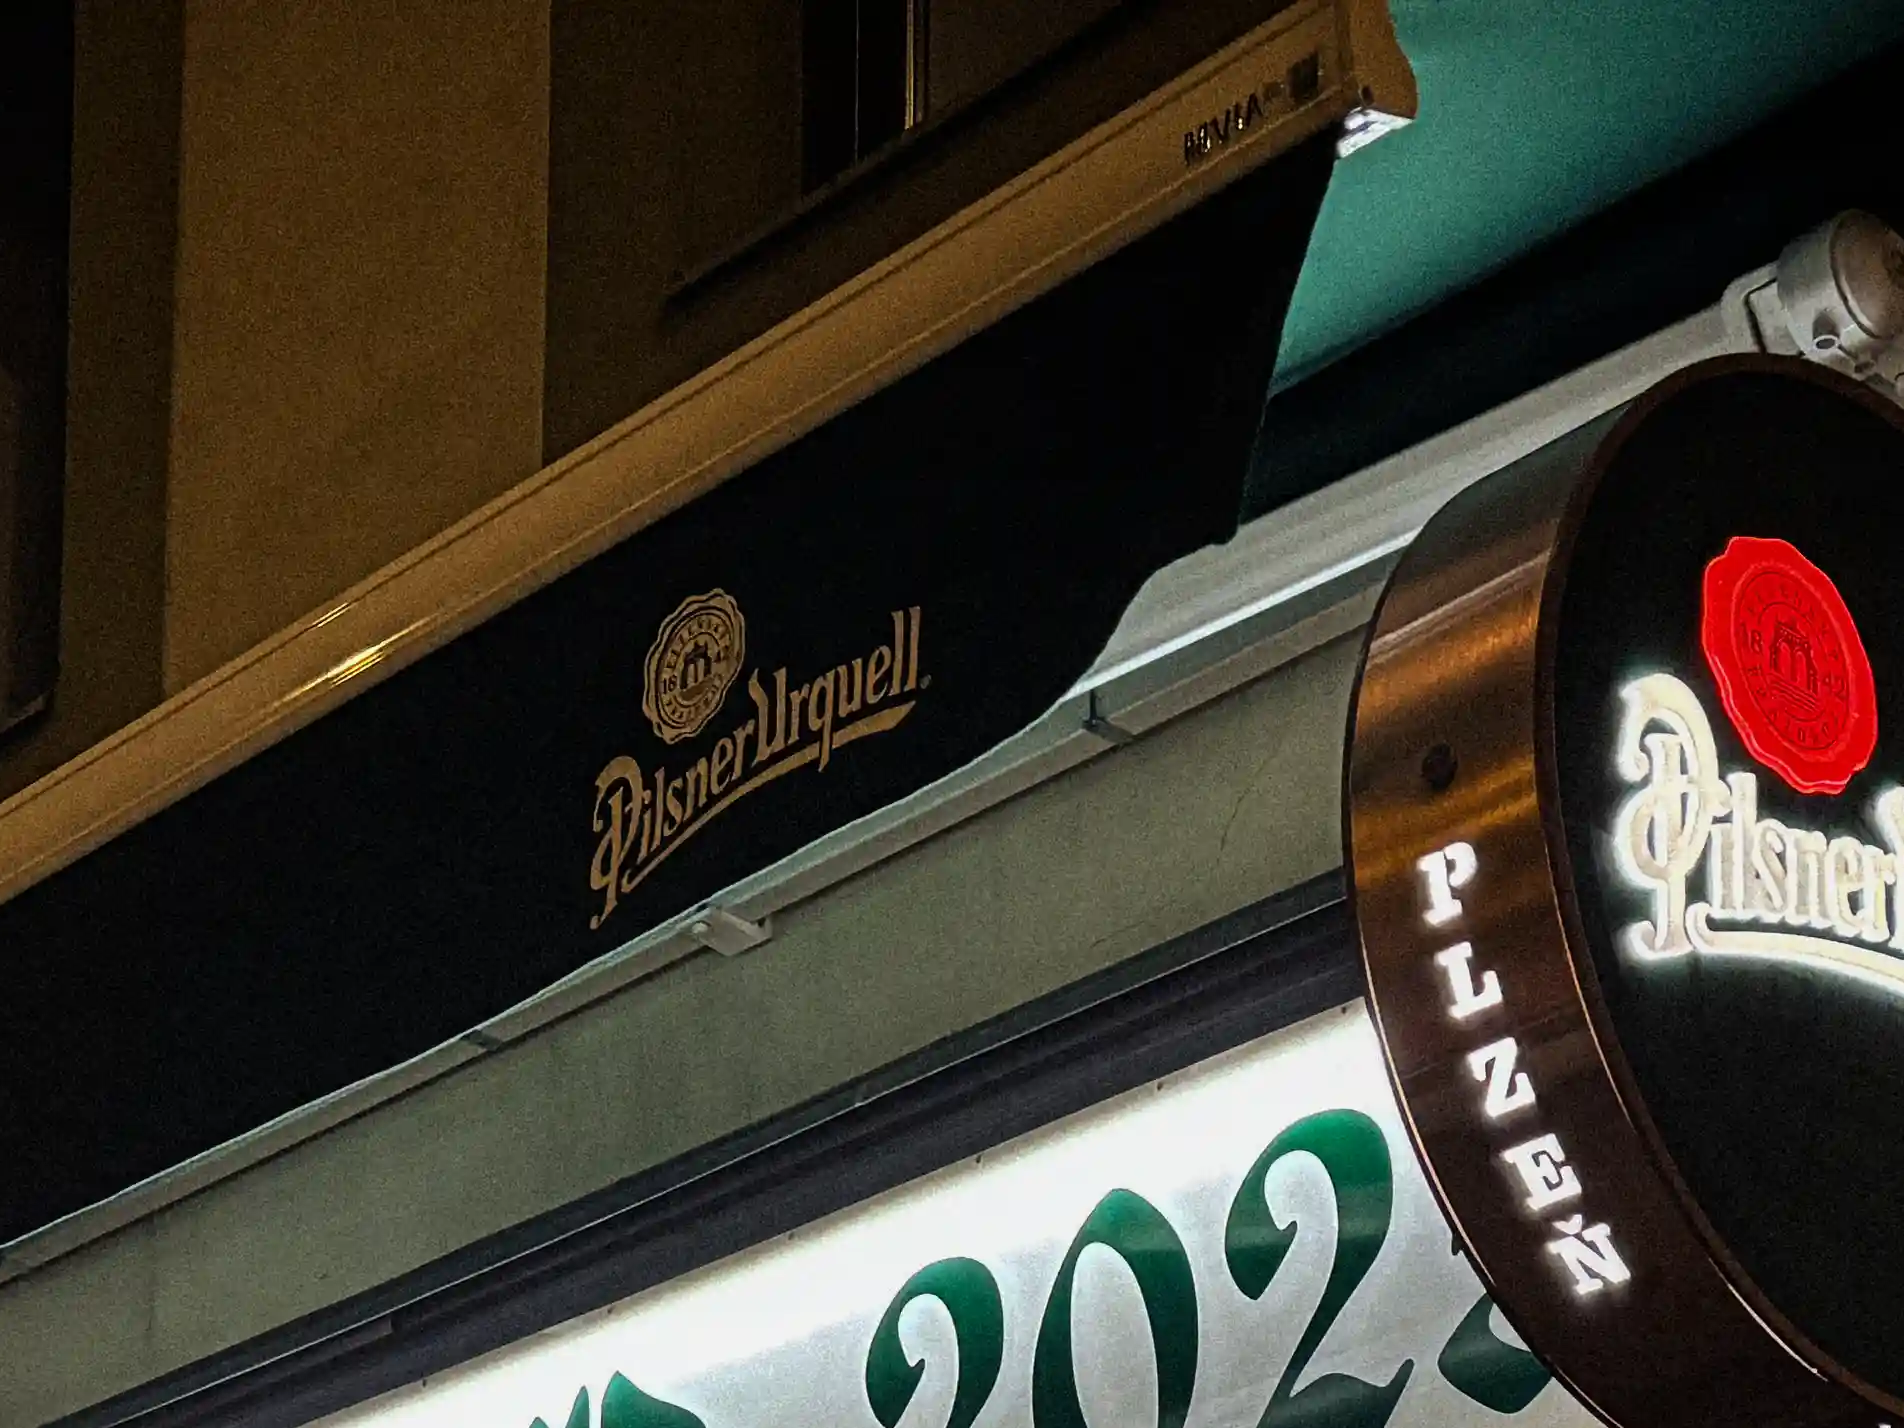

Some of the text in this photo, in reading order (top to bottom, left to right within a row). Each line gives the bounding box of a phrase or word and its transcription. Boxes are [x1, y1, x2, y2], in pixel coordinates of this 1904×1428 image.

[590, 605, 922, 929] Pilsner Urquell
[1614, 672, 1896, 962] Pilsner
[1416, 842, 1633, 1298] PLZEŇ
